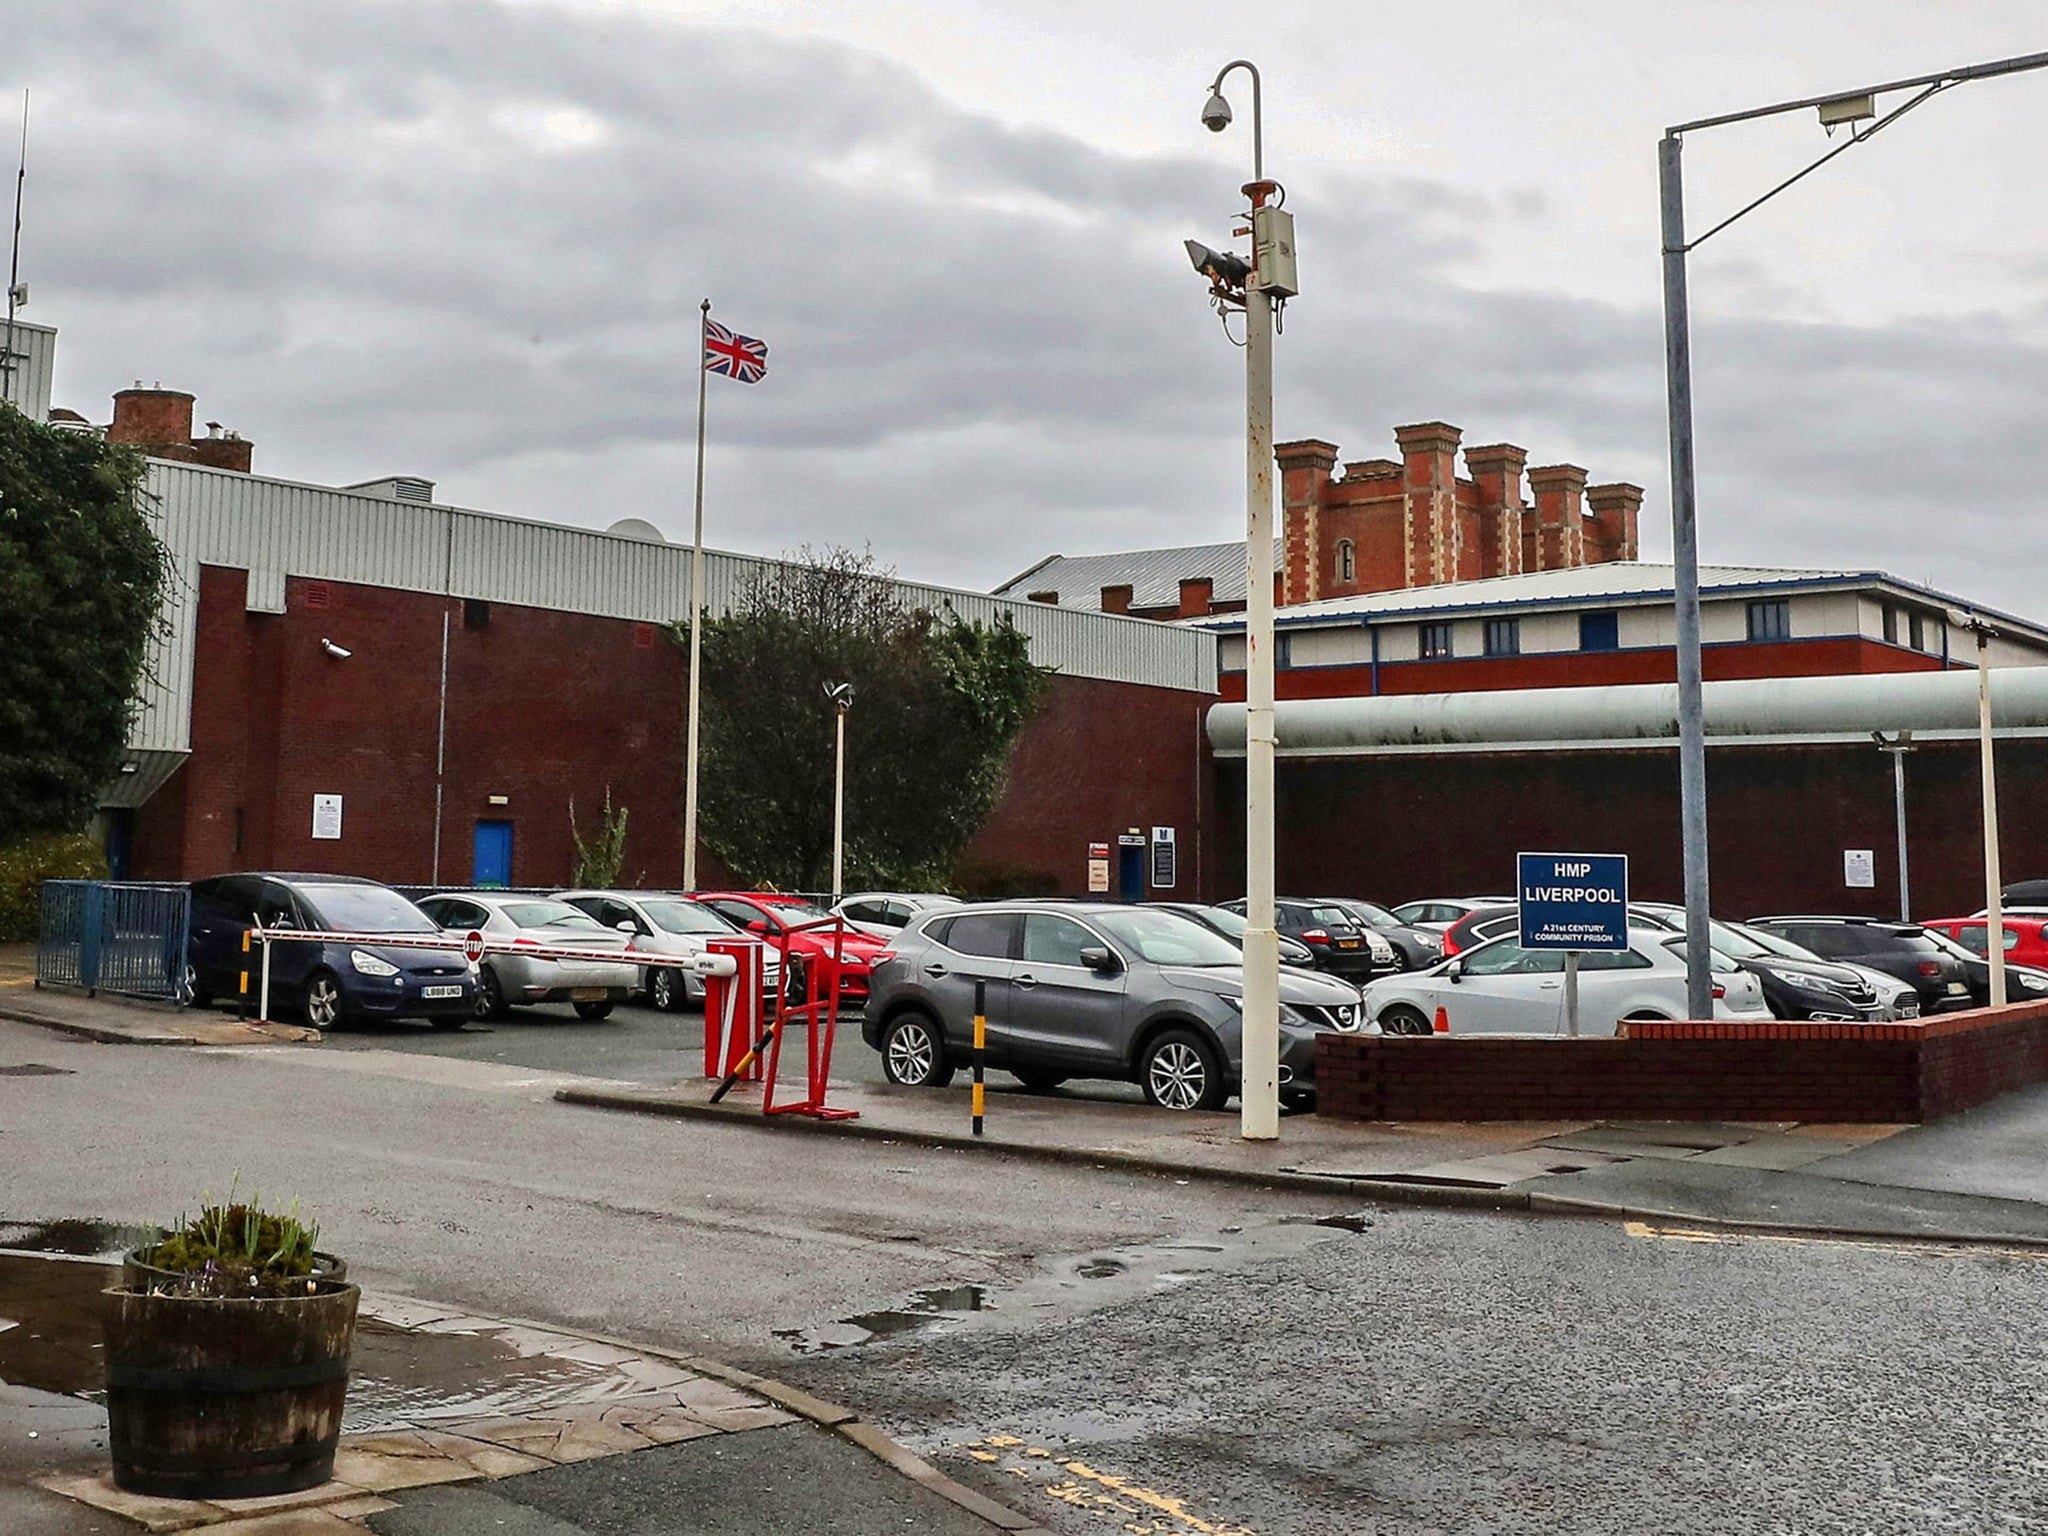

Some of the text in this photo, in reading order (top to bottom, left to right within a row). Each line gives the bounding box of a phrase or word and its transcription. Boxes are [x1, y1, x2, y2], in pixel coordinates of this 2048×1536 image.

[1554, 863, 1591, 877] HMP
[1525, 887, 1621, 903] LIVERPOOL
[1543, 924, 1549, 932] A
[1567, 924, 1605, 932] CENTURY
[1535, 933, 1614, 942] COMMUNITY PRISON
[465, 940, 483, 952] STOP
